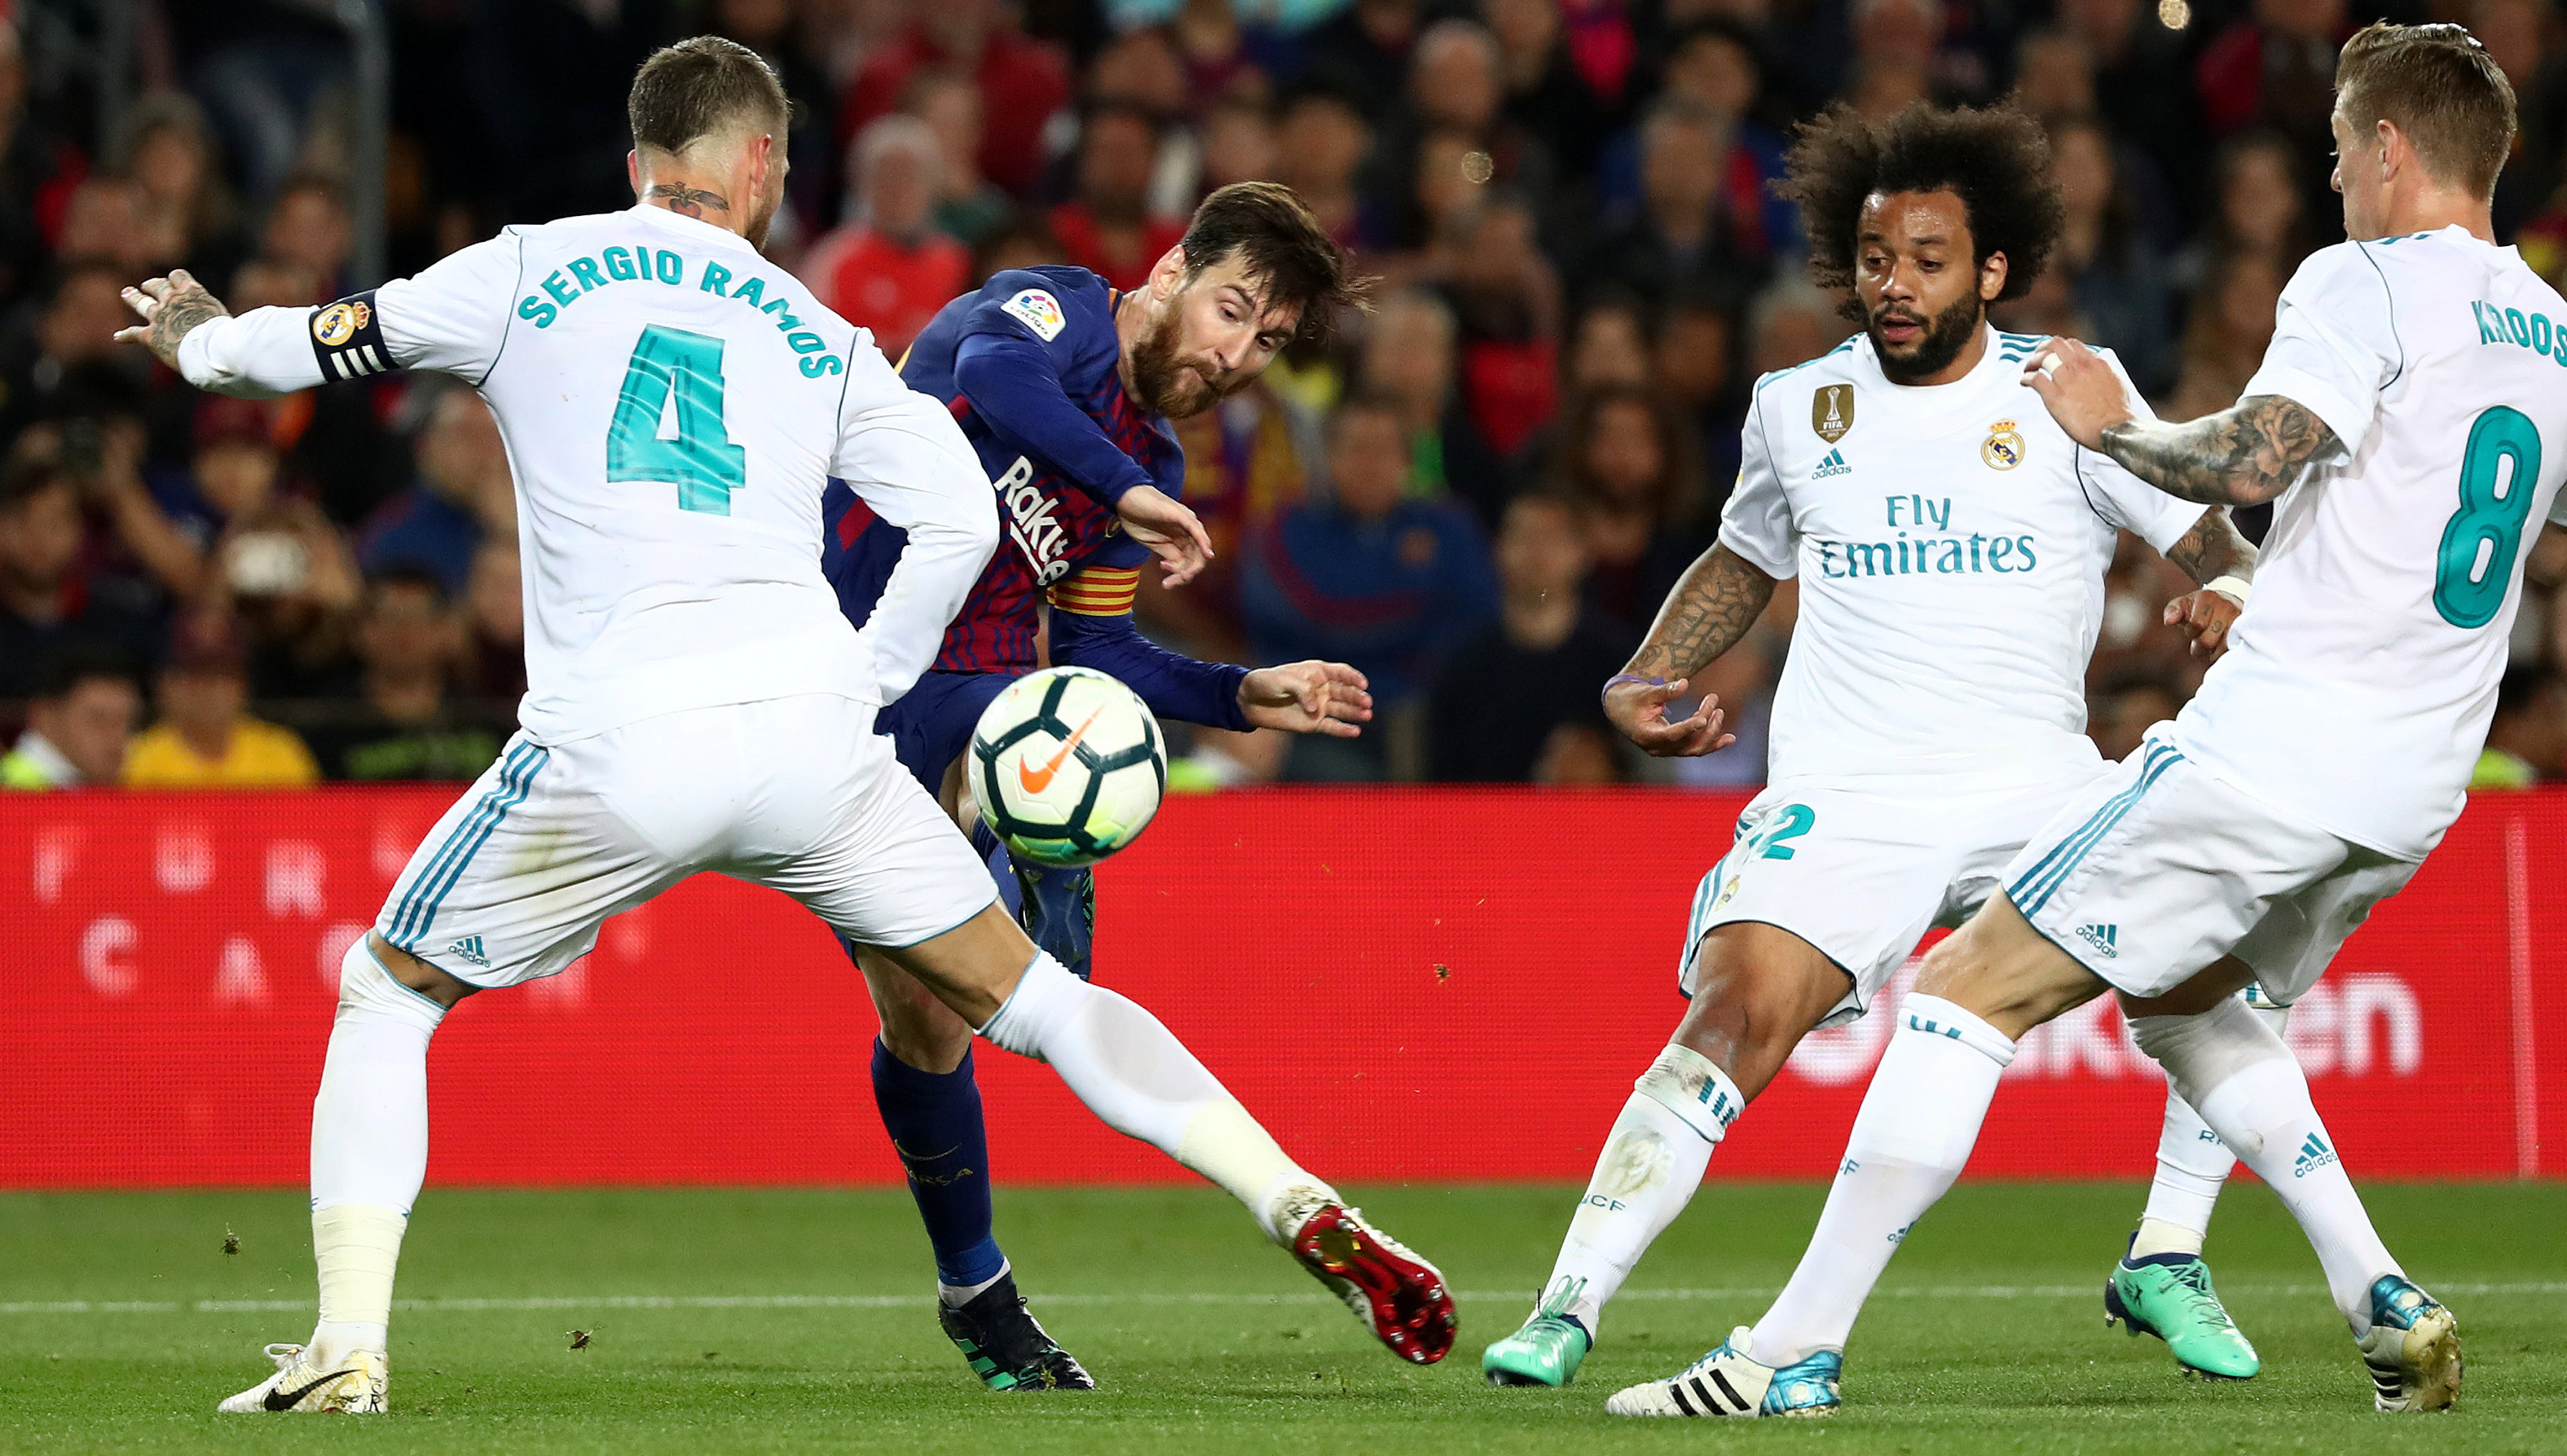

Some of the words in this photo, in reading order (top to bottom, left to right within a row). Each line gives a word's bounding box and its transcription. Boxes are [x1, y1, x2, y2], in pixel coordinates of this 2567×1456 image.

[518, 246, 683, 329] SERGIO
[700, 261, 843, 379] RAMOS
[2471, 299, 2567, 367] KROOS
[607, 323, 745, 516] 4
[1823, 420, 1843, 430] FIFA
[1812, 465, 1851, 480] adidas
[1886, 494, 1951, 530] Fly
[2433, 405, 2542, 629] 8
[1821, 531, 2036, 579] Emirates
[448, 945, 491, 968] adidas
[2076, 926, 2117, 958] adidas
[2295, 1151, 2338, 1178] adidas
